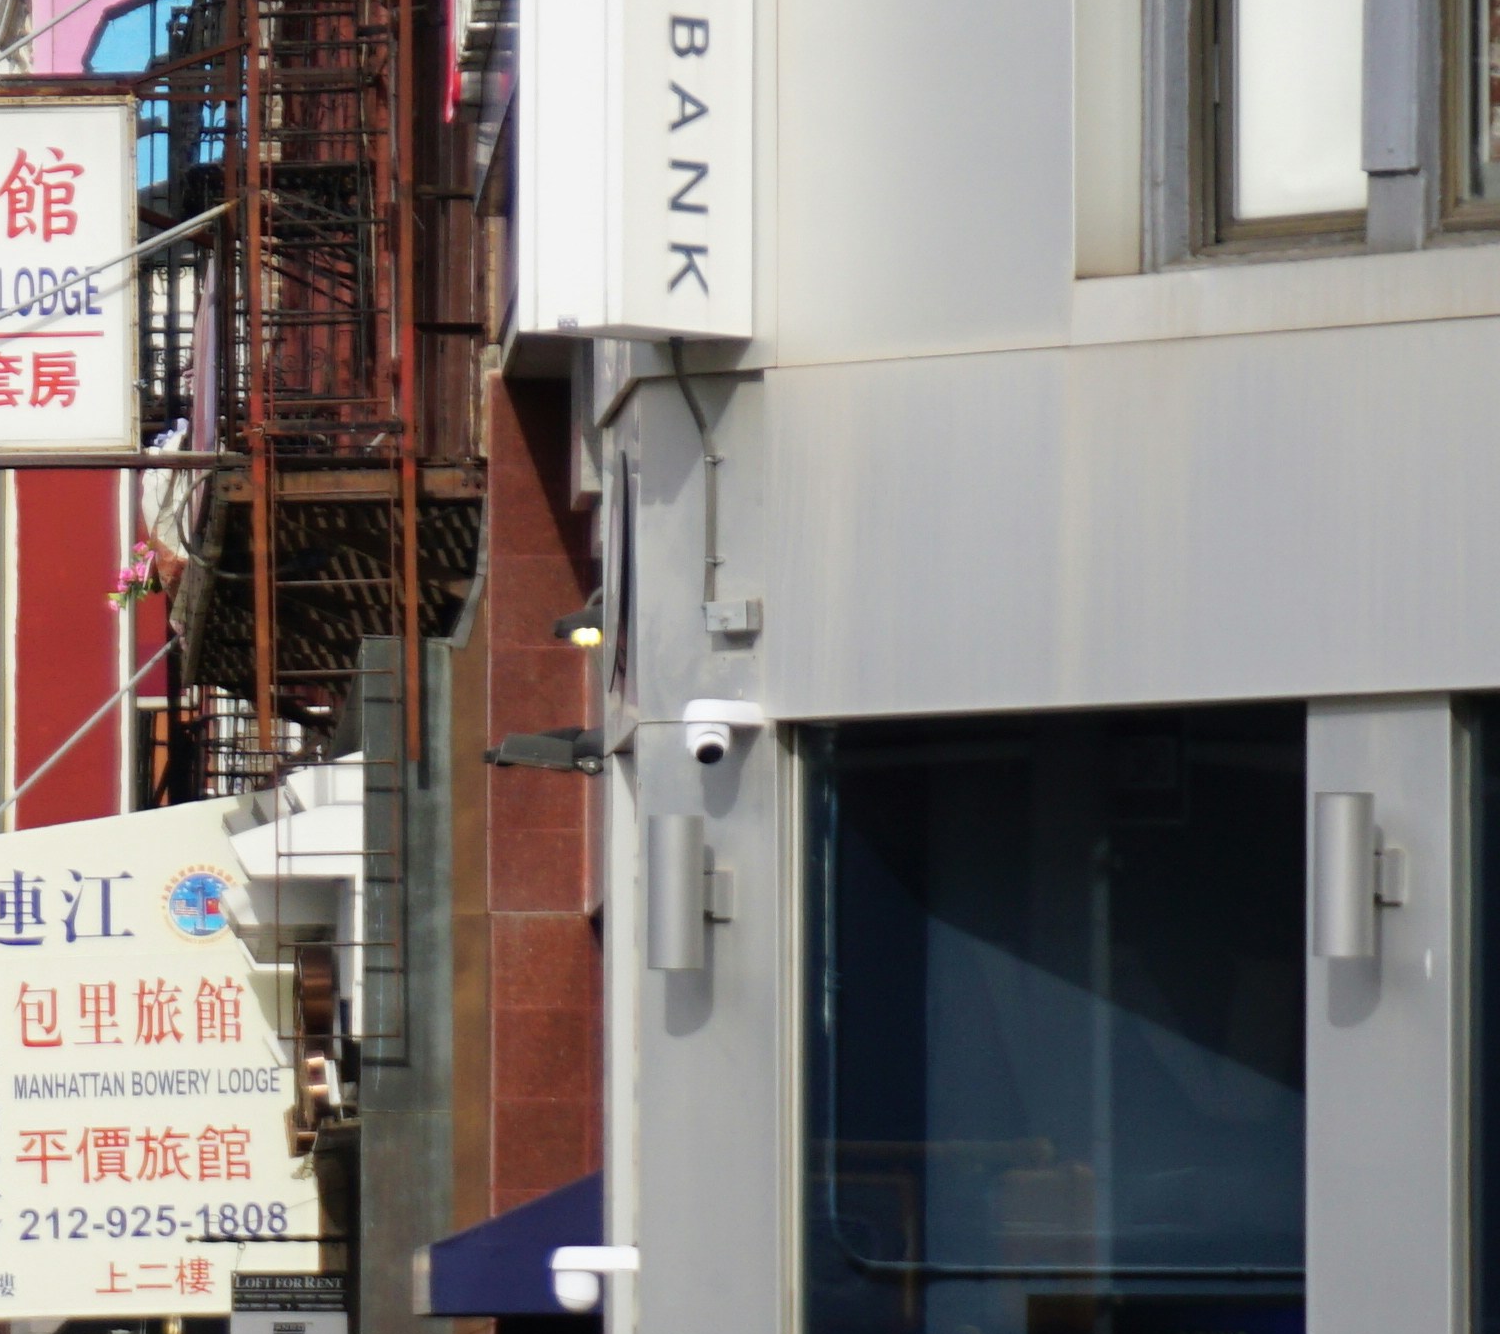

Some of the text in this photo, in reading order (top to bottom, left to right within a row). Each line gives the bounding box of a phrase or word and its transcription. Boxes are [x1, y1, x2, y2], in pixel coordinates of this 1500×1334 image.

[668, 16, 710, 299] BANK
[14, 976, 245, 1047] 包里旅館
[13, 1066, 281, 1100] MANHATTAN BOWERY LODGE
[15, 1125, 252, 1185] 平價旅館
[19, 1202, 289, 1242] 212-925-1808
[95, 1256, 216, 1296] 上二樓
[235, 1275, 344, 1288] LOFT FOR RENT
